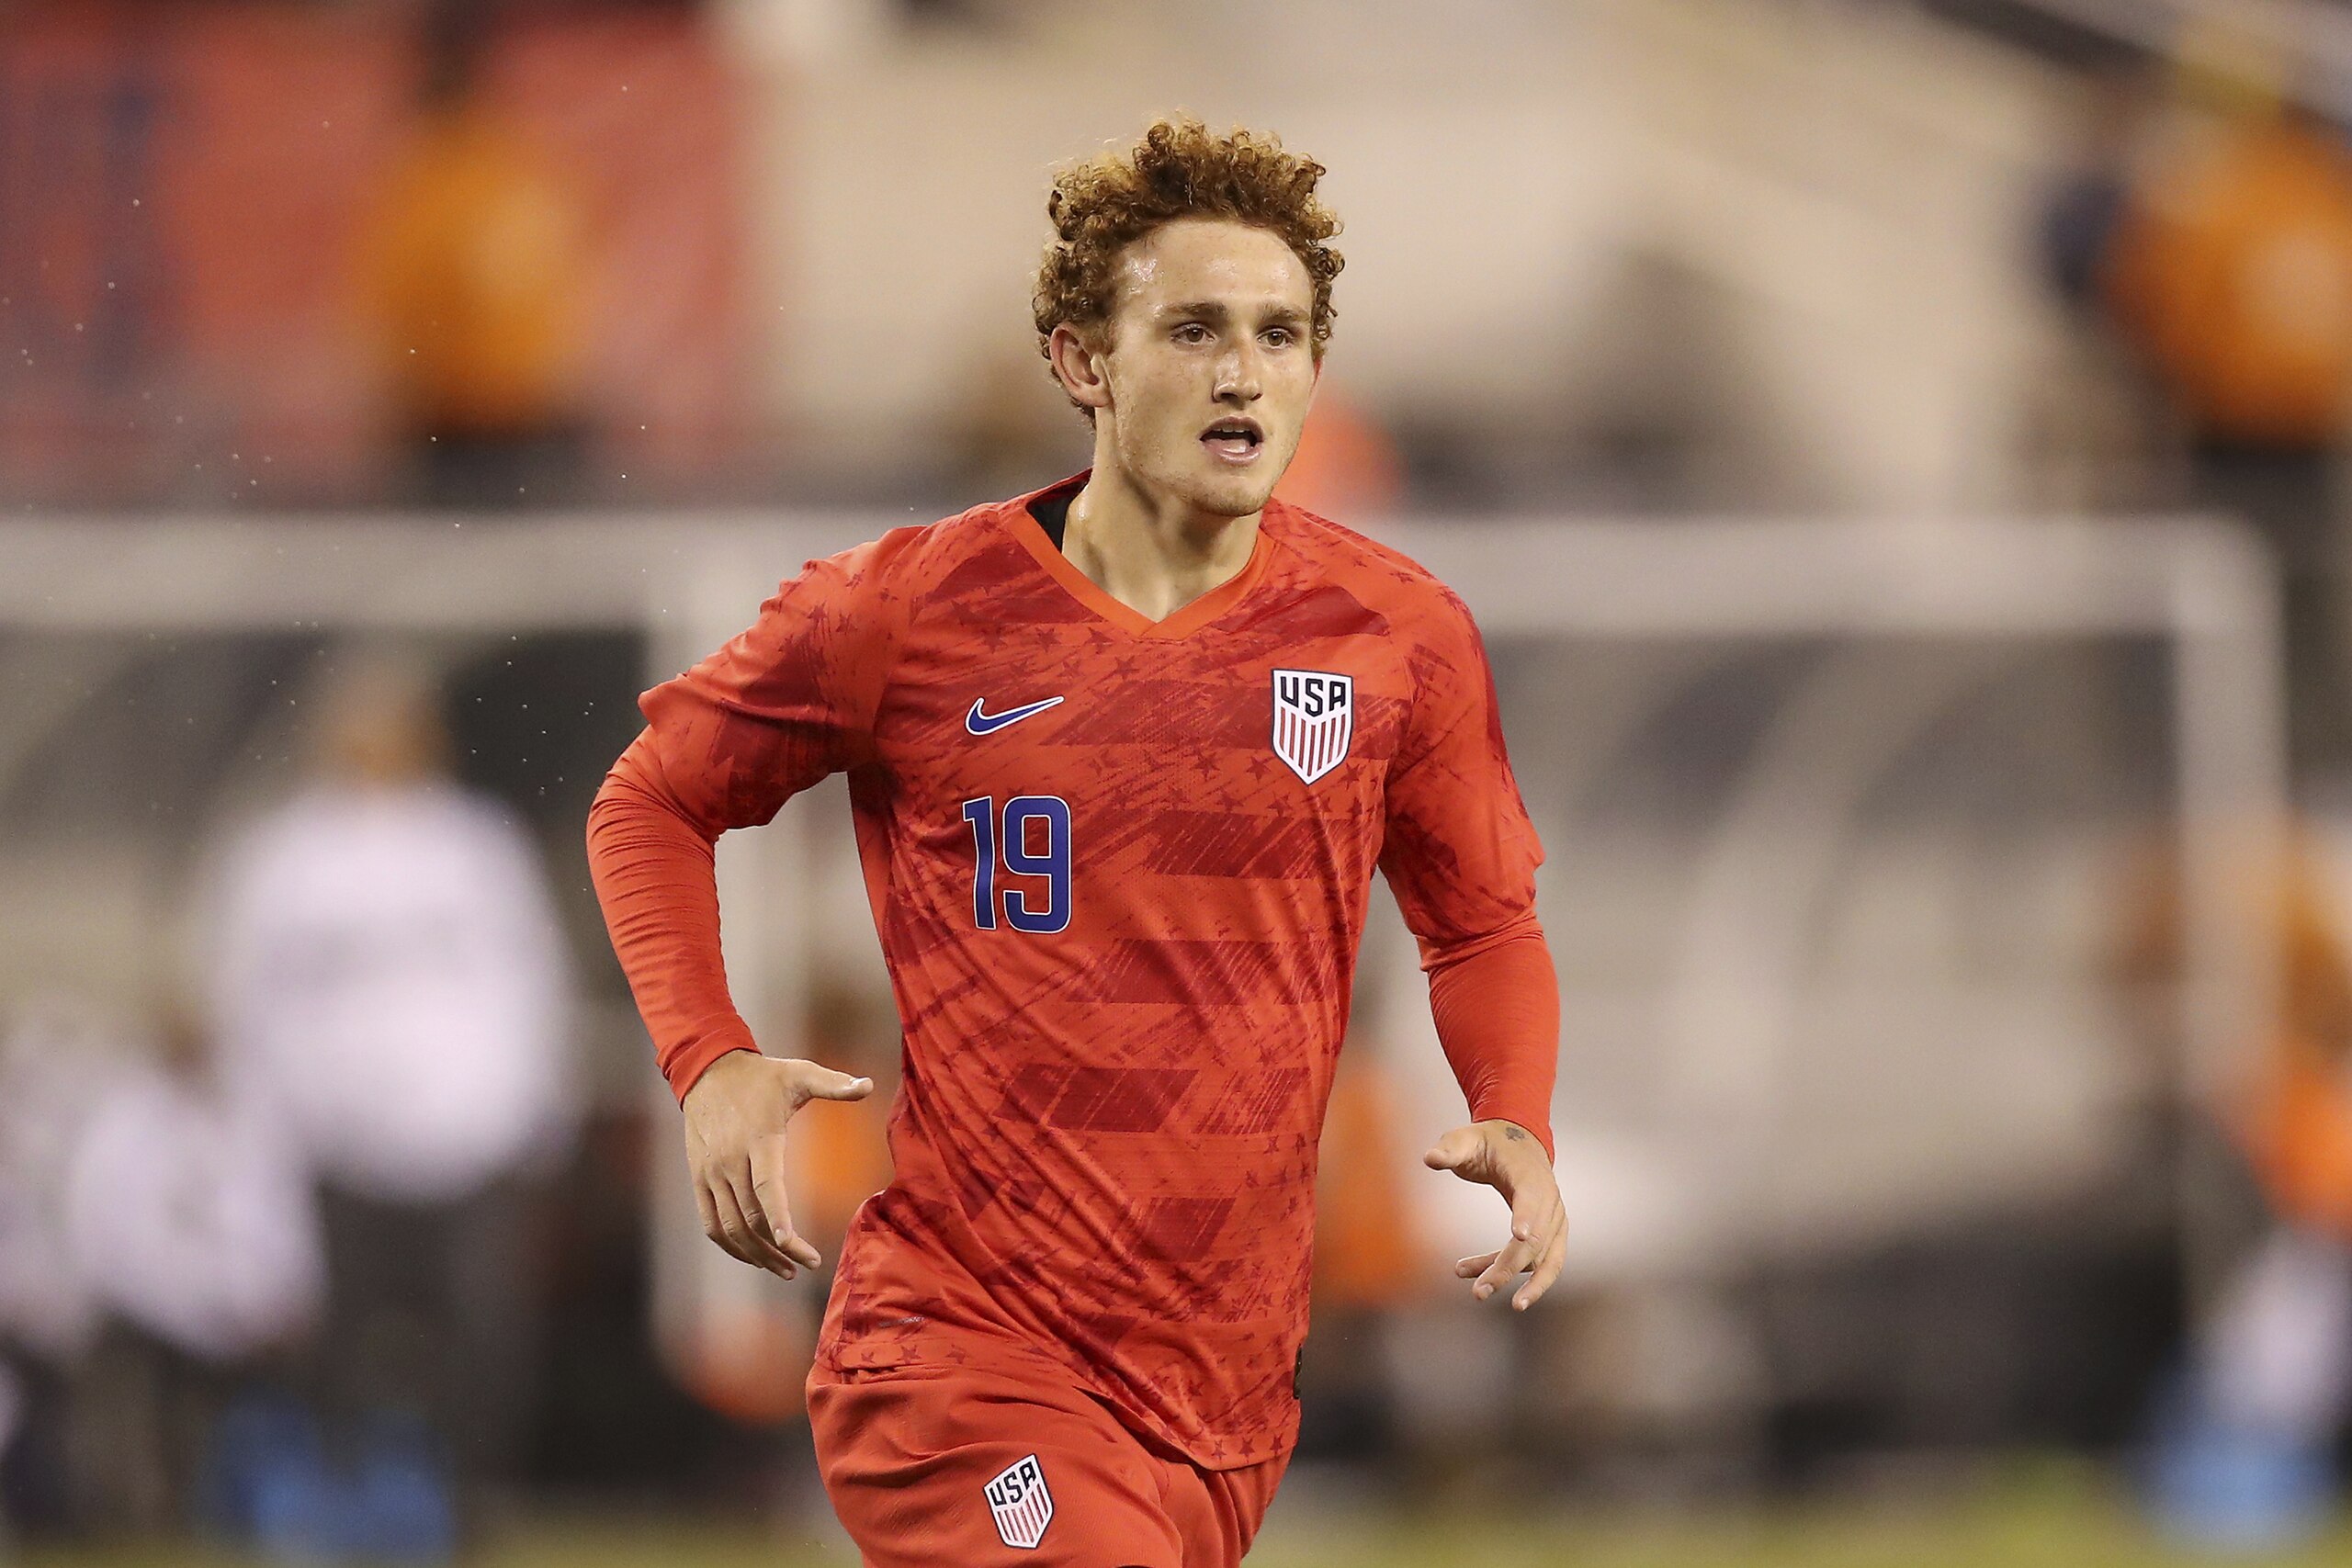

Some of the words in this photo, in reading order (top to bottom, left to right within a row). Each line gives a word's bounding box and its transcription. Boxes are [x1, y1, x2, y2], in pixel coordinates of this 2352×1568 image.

[1280, 676, 1347, 717] USA
[962, 795, 1072, 934] 19
[989, 1461, 1037, 1506] USA
